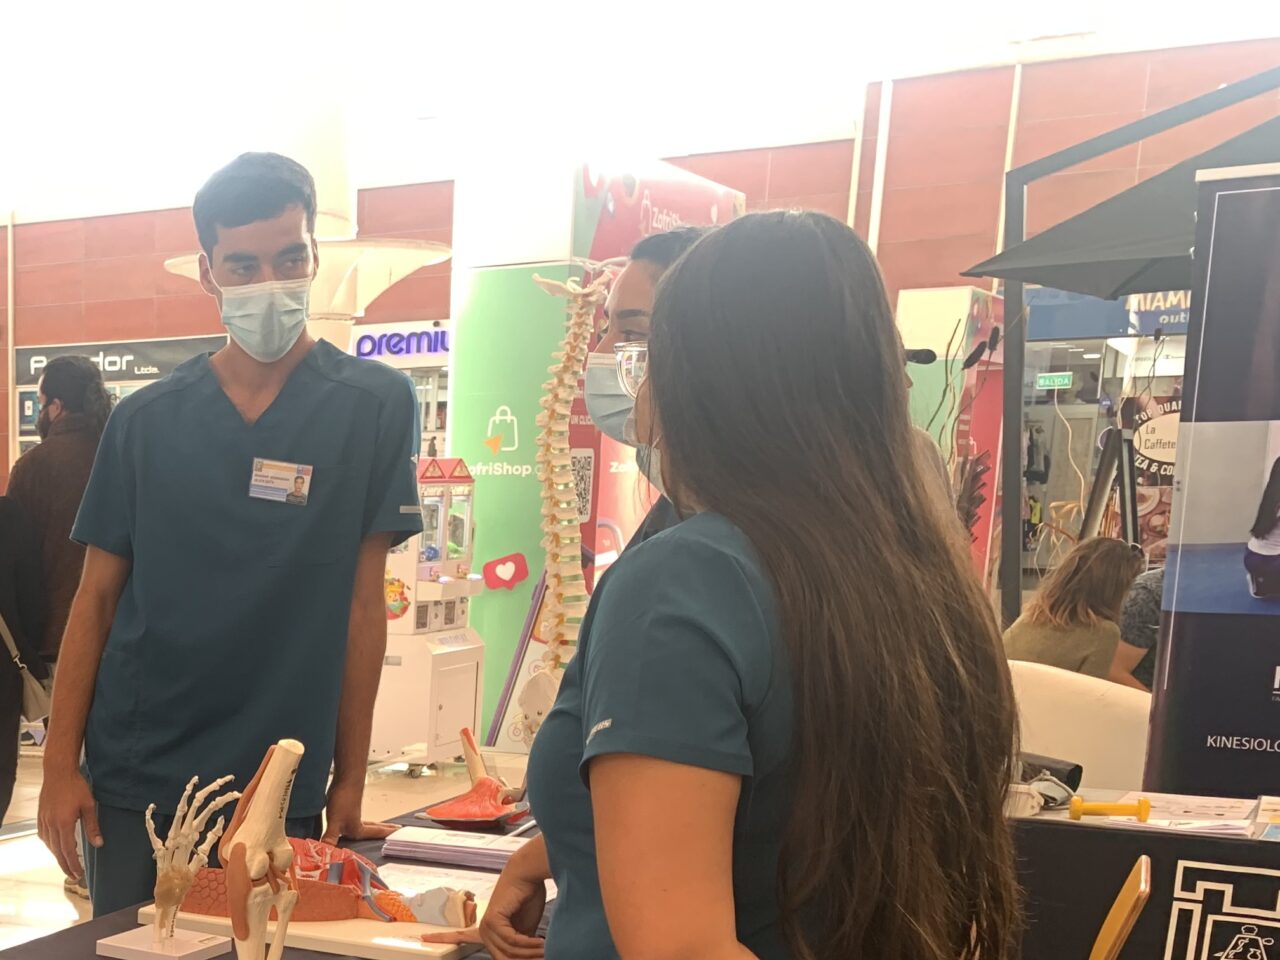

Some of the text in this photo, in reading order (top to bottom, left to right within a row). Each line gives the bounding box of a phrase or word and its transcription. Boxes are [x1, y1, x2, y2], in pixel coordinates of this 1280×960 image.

[1038, 376, 1069, 386] SALIDA
[1145, 424, 1156, 434] La
[1150, 462, 1159, 473] &
